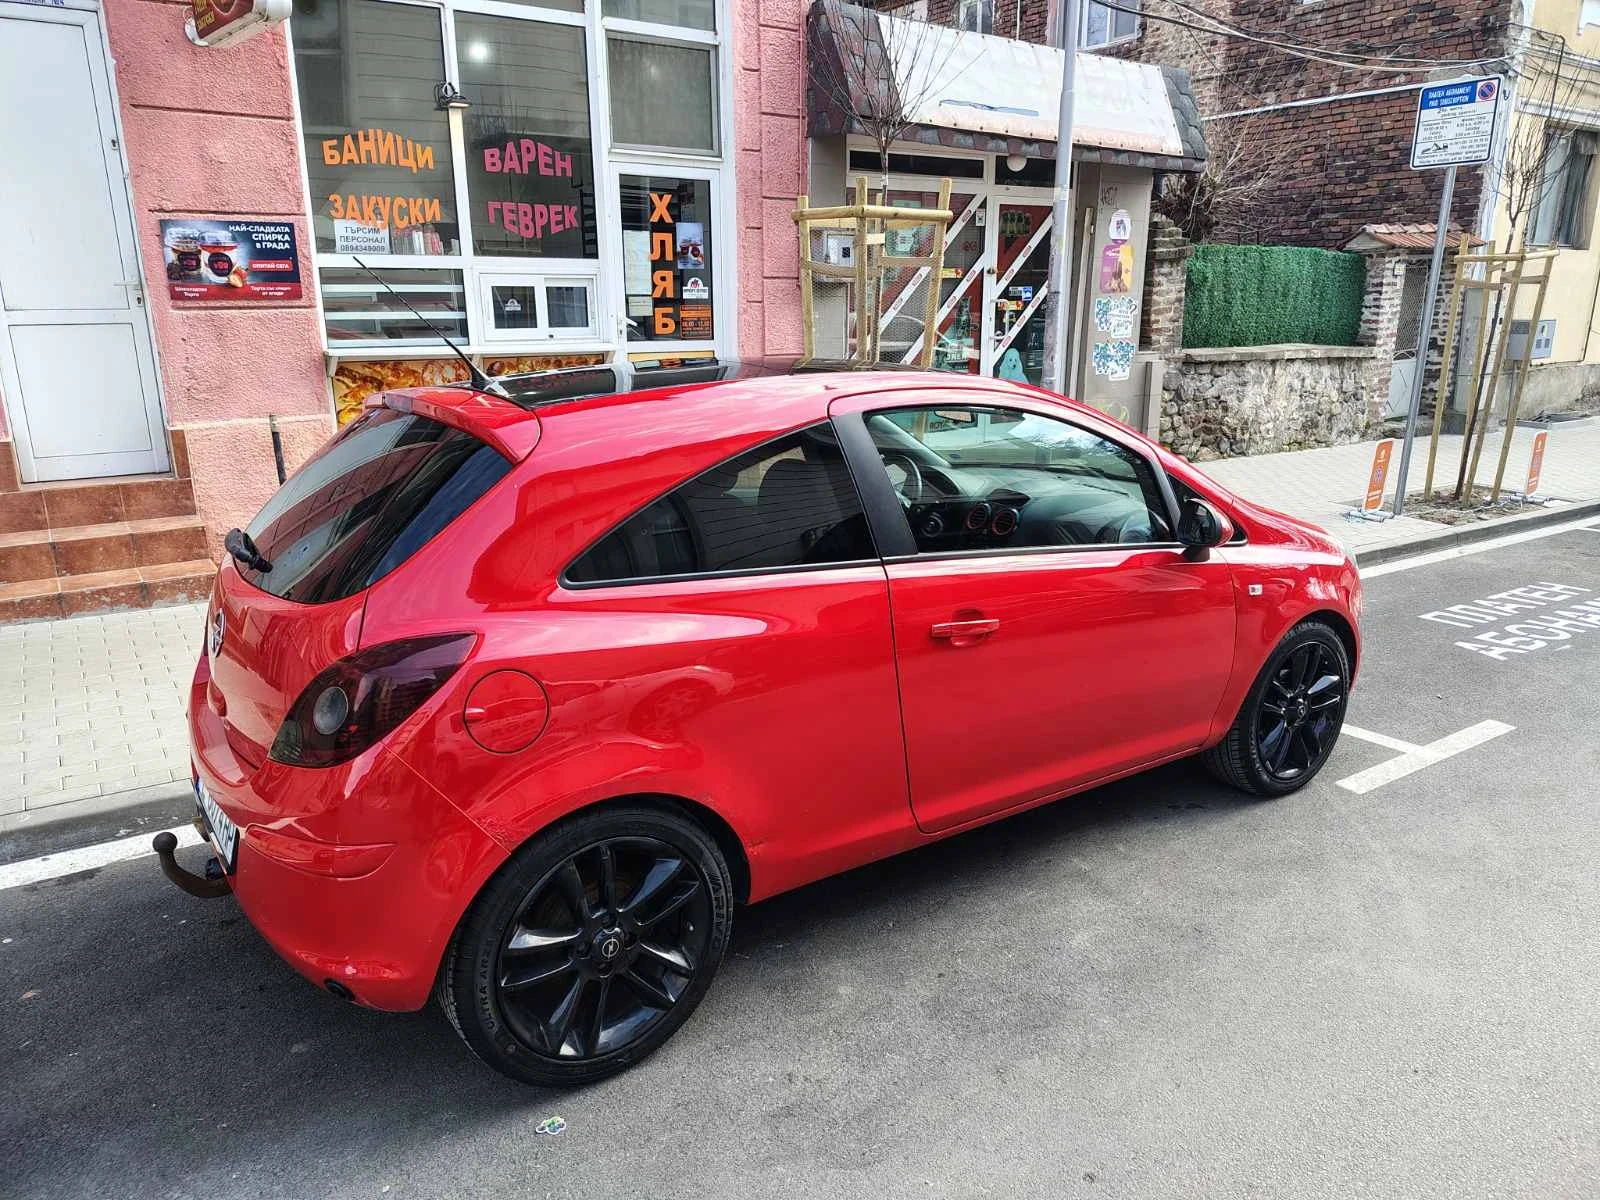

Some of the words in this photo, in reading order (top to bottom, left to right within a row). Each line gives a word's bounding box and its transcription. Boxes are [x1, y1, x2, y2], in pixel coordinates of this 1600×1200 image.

[322, 128, 435, 174] БАНИЦИ
[484, 138, 573, 177] ВАРЕН
[229, 224, 291, 234] НАЙ-СЛАДКАТА
[328, 193, 442, 230] ЗАКУСКИ
[487, 201, 578, 239] ГЕВРЕК
[252, 233, 291, 242] СПИРКА
[262, 241, 291, 250] ГРАДА
[339, 235, 386, 244] ПЕРСОНАЛ
[344, 226, 381, 235] ТЪРСИМ
[648, 191, 676, 336] ХЛЯБ
[1417, 582, 1593, 628] ПЛАТЕН
